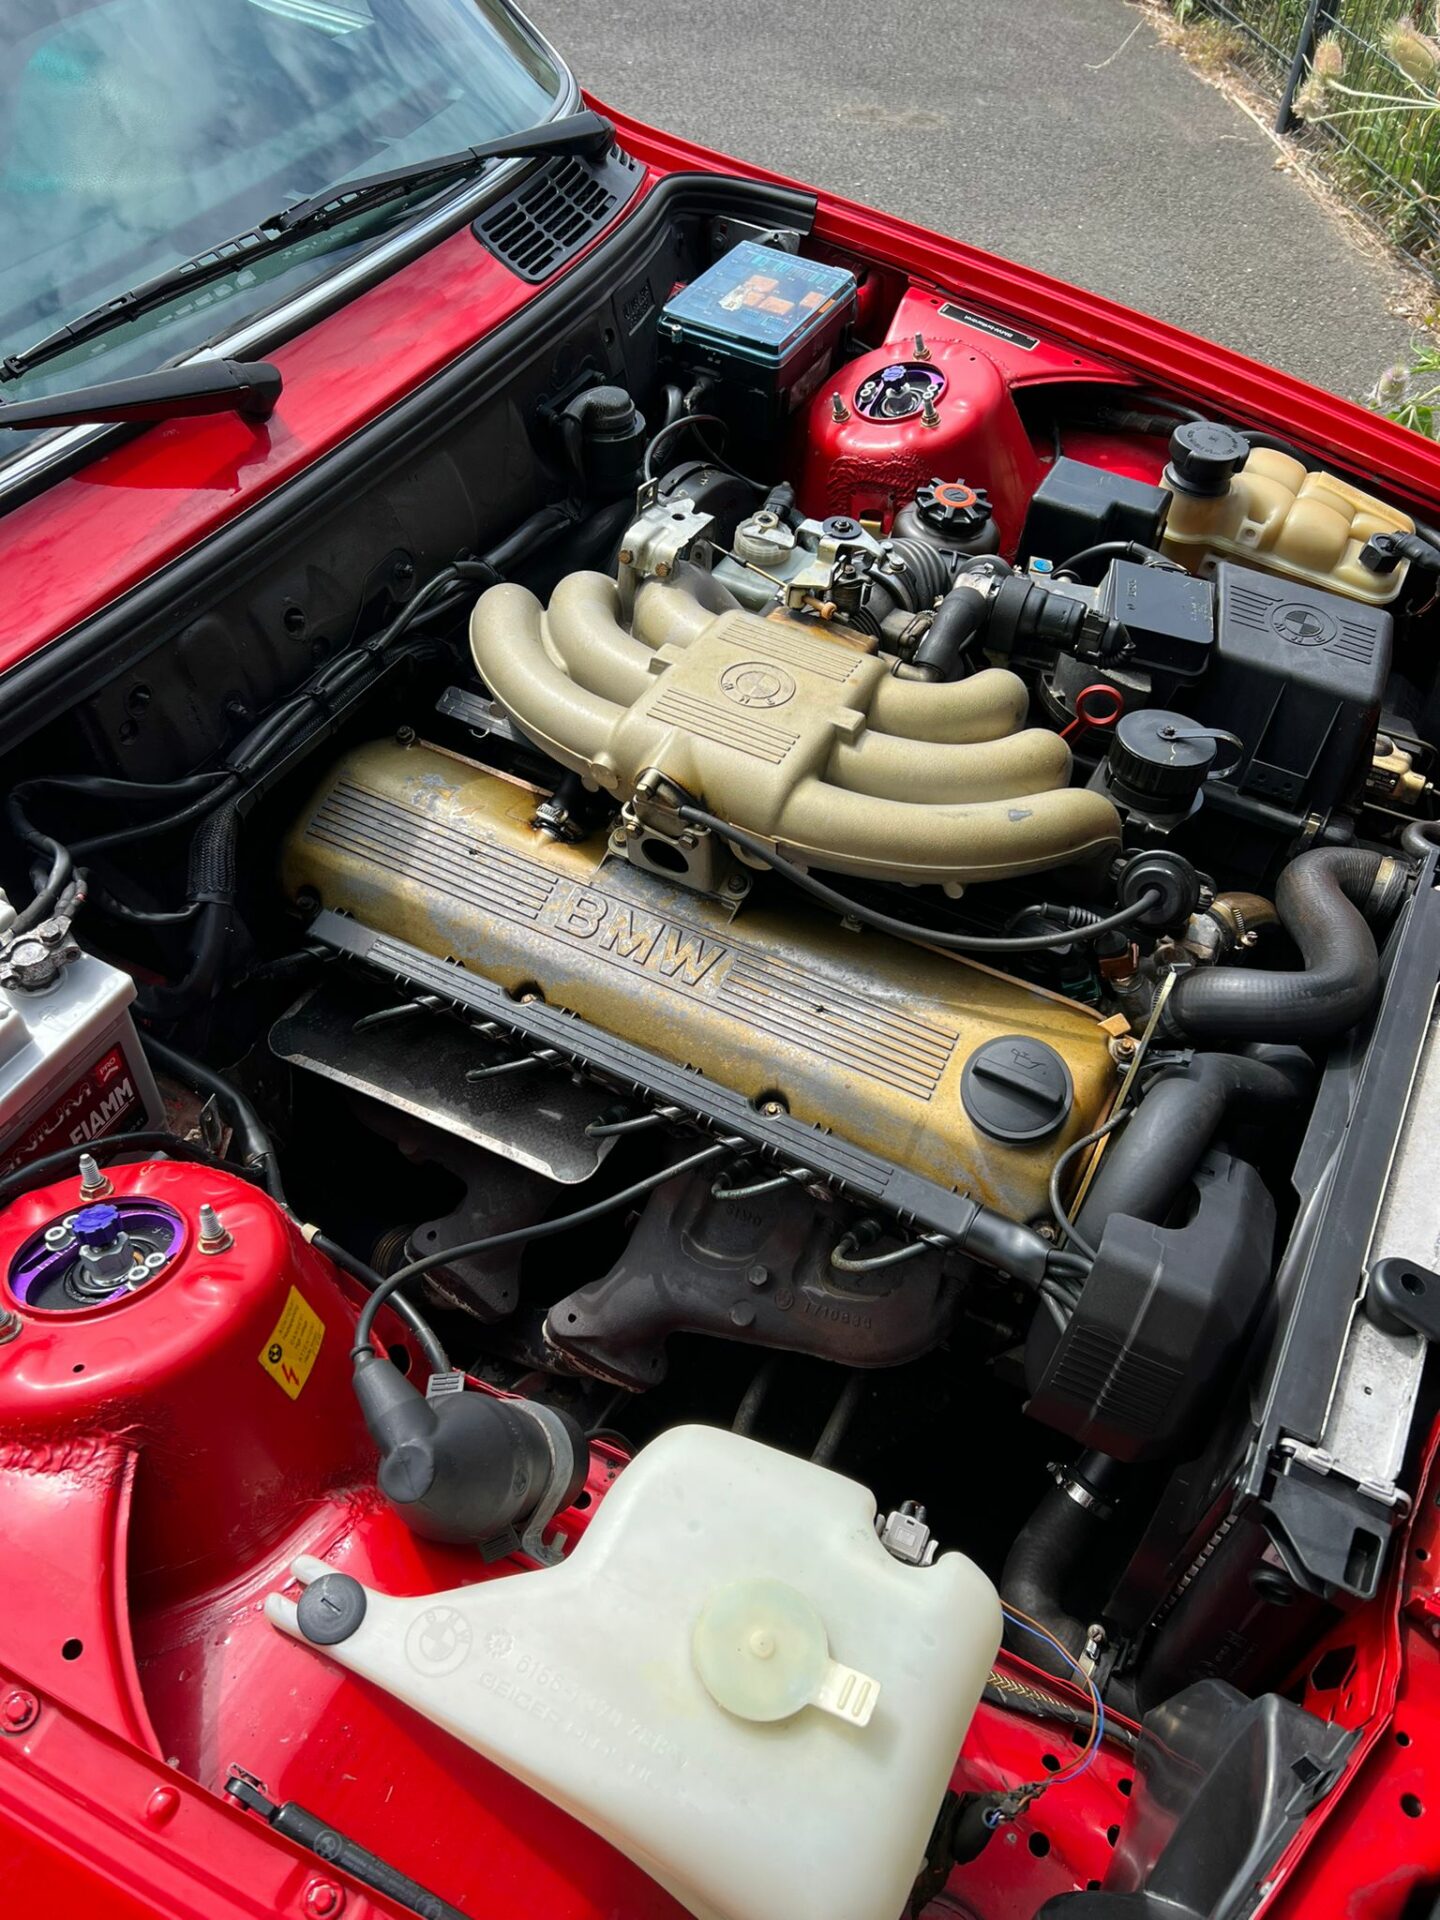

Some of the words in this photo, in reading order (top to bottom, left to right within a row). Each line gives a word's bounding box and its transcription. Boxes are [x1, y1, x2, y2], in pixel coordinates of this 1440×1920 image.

[554, 885, 727, 987] BMW
[100, 1057, 116, 1075] PRO
[69, 1077, 134, 1145] FIAMM
